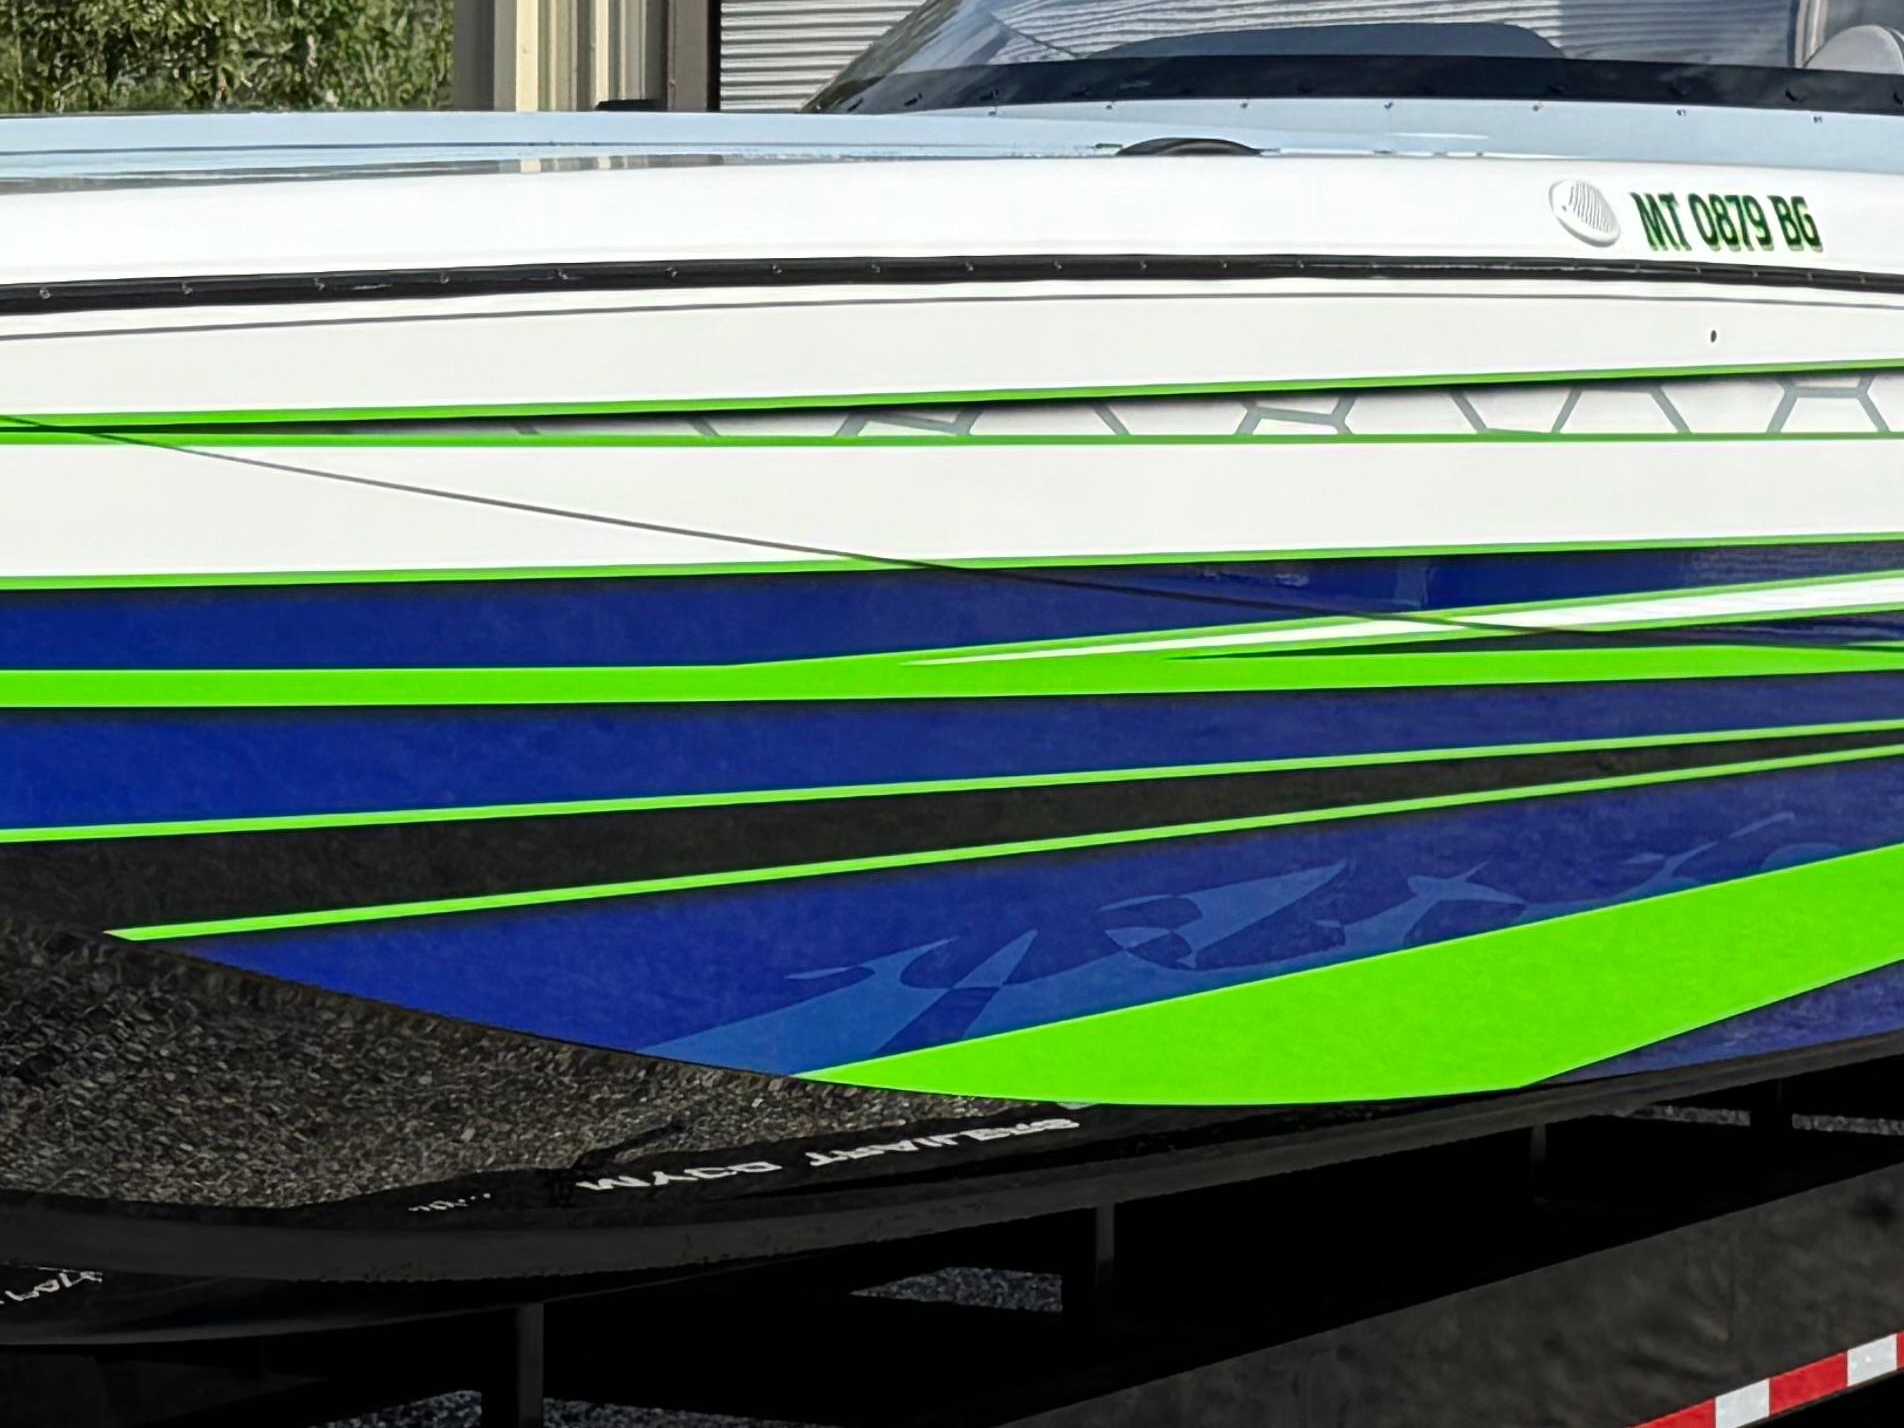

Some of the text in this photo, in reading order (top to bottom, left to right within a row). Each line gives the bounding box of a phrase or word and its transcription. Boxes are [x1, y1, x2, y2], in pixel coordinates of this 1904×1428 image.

[1629, 192, 1824, 252] MT 0879 BG
